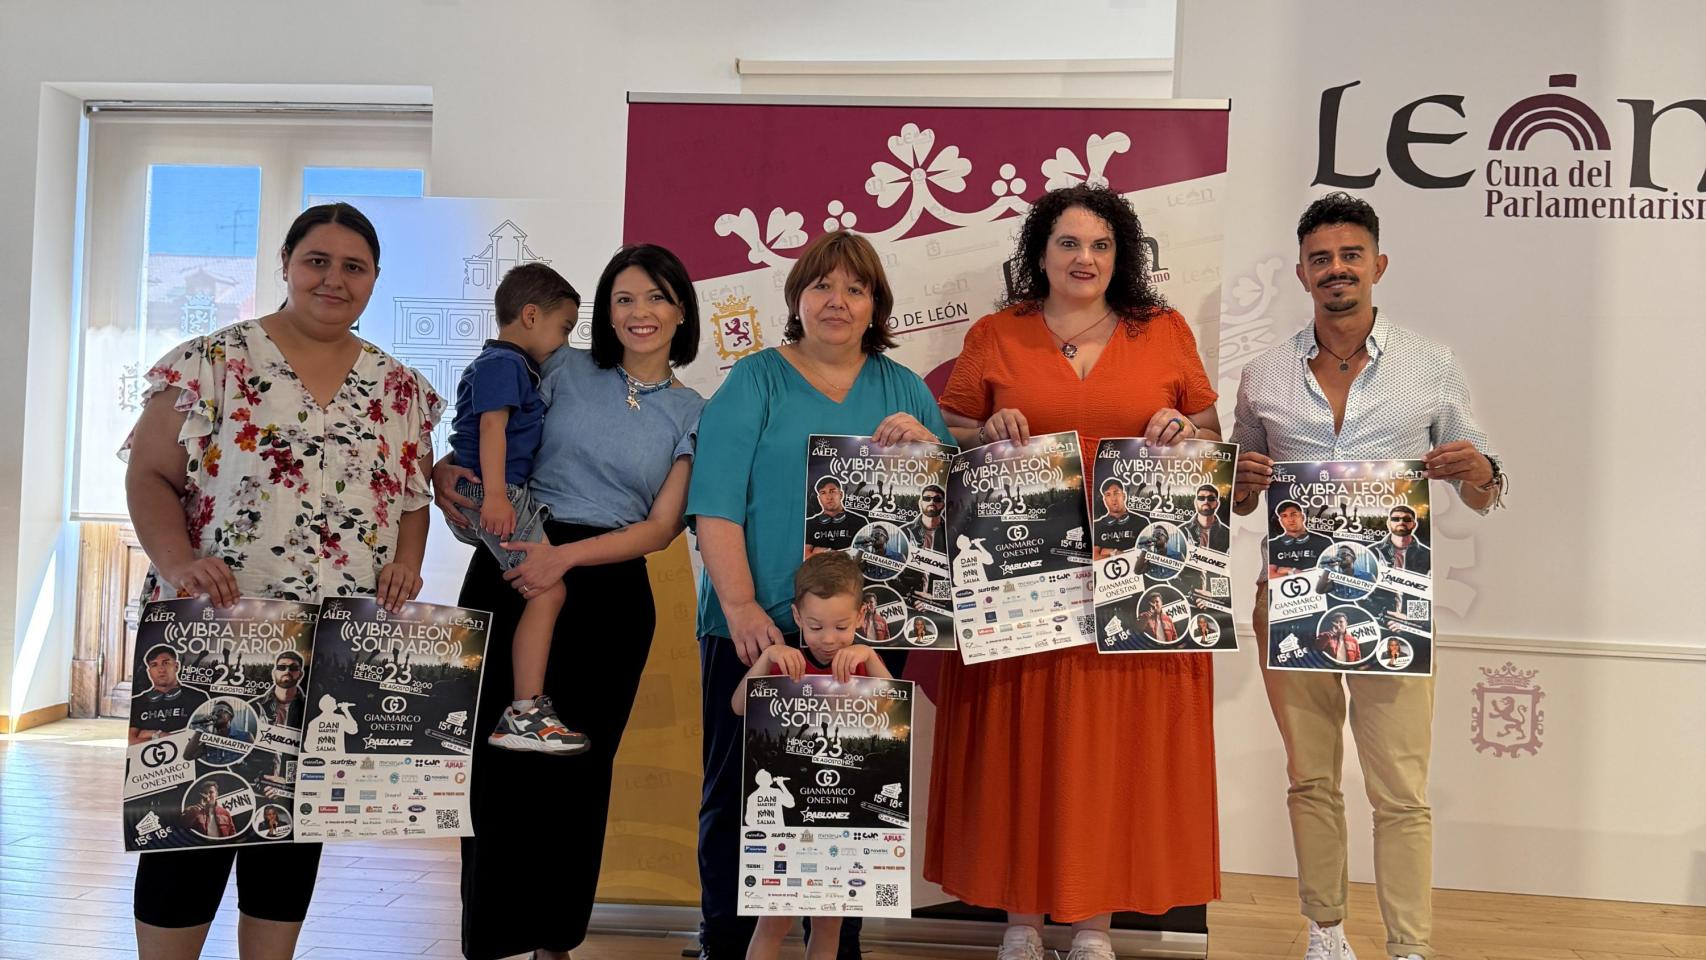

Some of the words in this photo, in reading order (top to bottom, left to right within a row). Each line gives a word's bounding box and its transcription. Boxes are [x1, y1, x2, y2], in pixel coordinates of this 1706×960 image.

[1486, 159, 1559, 188] Cuna
[1568, 160, 1612, 188] del
[904, 312, 923, 329] DE
[928, 302, 968, 322] LEÓN
[842, 458, 886, 471] VIBRA
[890, 456, 929, 472] LEÓN
[971, 464, 1010, 479] VIBRA
[1013, 456, 1051, 472] LEÓN
[1122, 459, 1164, 472] VIBRA
[1168, 457, 1203, 473] LEÓN
[841, 471, 928, 486] SOLIDARIO
[971, 470, 1052, 494] SOLIDARIO
[1122, 472, 1203, 486] SOLIDARIO
[1300, 483, 1348, 495] VIBRA
[1354, 480, 1395, 496] LEÓN
[871, 494, 896, 512] 23
[1001, 497, 1026, 515] 23
[1151, 495, 1174, 512] 23
[1300, 496, 1395, 508] SOLIDARIO
[1175, 508, 1194, 516] 20:00
[1335, 516, 1362, 533] 23
[814, 530, 851, 539] CHANEL
[1101, 531, 1135, 540] CHANEL
[996, 538, 1044, 551] GIANMARCO
[863, 554, 878, 562] DANI
[1003, 547, 1039, 558] ONESTINI
[1278, 550, 1316, 560] CHANEL
[961, 556, 978, 564] DANI
[1005, 560, 1042, 571] PABLONEZ
[1193, 554, 1226, 568] PABLONEZ
[1099, 576, 1140, 592] GIANMARCO
[1330, 573, 1346, 581] DANI
[1385, 574, 1428, 591] PABLONEZ
[1106, 585, 1137, 598] ONESTINI
[1275, 595, 1322, 609] GIANMARCO
[1283, 604, 1318, 616] ONESTINI
[179, 622, 234, 637] VIBRA
[240, 619, 284, 638] LEÓN
[354, 622, 404, 638] VIBRA
[409, 622, 452, 640] LEÓN
[177, 637, 283, 654] SOLIDARIO
[351, 636, 450, 656] SOLIDARIO
[181, 673, 193, 681] DE
[193, 673, 212, 683] LEÓN
[214, 664, 245, 685] 23
[363, 671, 383, 681] LEÓN
[384, 662, 412, 684] 23
[245, 680, 271, 690] 20:00
[412, 681, 432, 689] 20:00
[782, 697, 831, 712] VIBRA
[836, 696, 877, 712] LEÓN
[140, 708, 188, 721] CHANEL
[364, 714, 421, 723] GIANMARCO
[781, 712, 877, 728] SOLIDARIO
[370, 723, 413, 731] ONESTINI
[438, 722, 451, 731] 15€
[453, 727, 467, 735] 18€
[202, 734, 219, 743] DANI
[369, 739, 413, 747] PABLONEZ
[814, 737, 842, 757] 23
[132, 762, 191, 784] GIANMARCO
[141, 773, 185, 790] ONESTINI
[800, 787, 855, 795] GIANMARCO
[807, 796, 848, 804] ONESTINI
[874, 794, 887, 803] 15€
[889, 799, 903, 808] 18€
[135, 835, 152, 847] 15€
[155, 826, 172, 840] 18€
